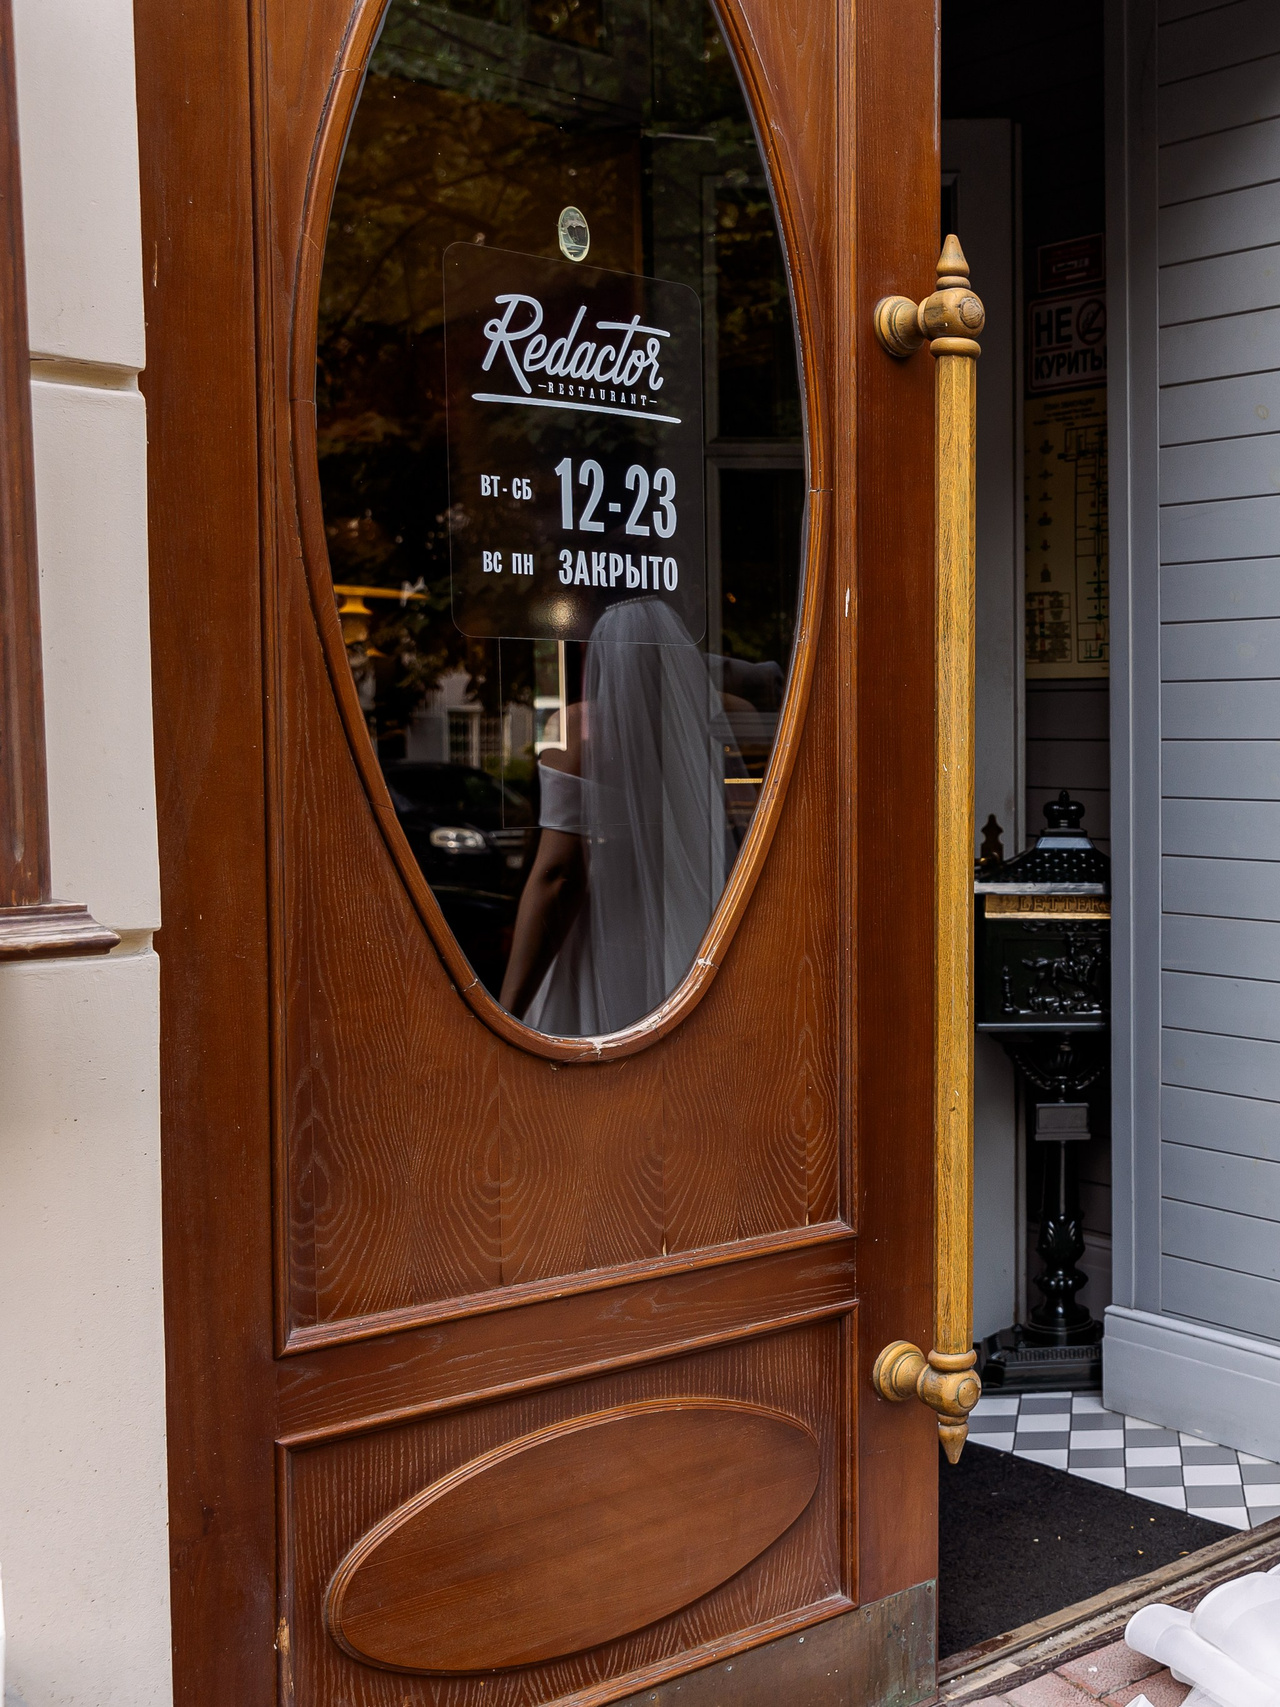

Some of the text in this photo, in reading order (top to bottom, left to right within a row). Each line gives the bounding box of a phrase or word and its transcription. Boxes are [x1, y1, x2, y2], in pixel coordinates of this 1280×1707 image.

[482, 294, 671, 393] Redactor
[1035, 306, 1073, 347] НЕ
[548, 381, 647, 406] RESTAURANT
[554, 457, 677, 539] 12-23
[483, 549, 679, 592] ВС ПН ЗАКРЫТО
